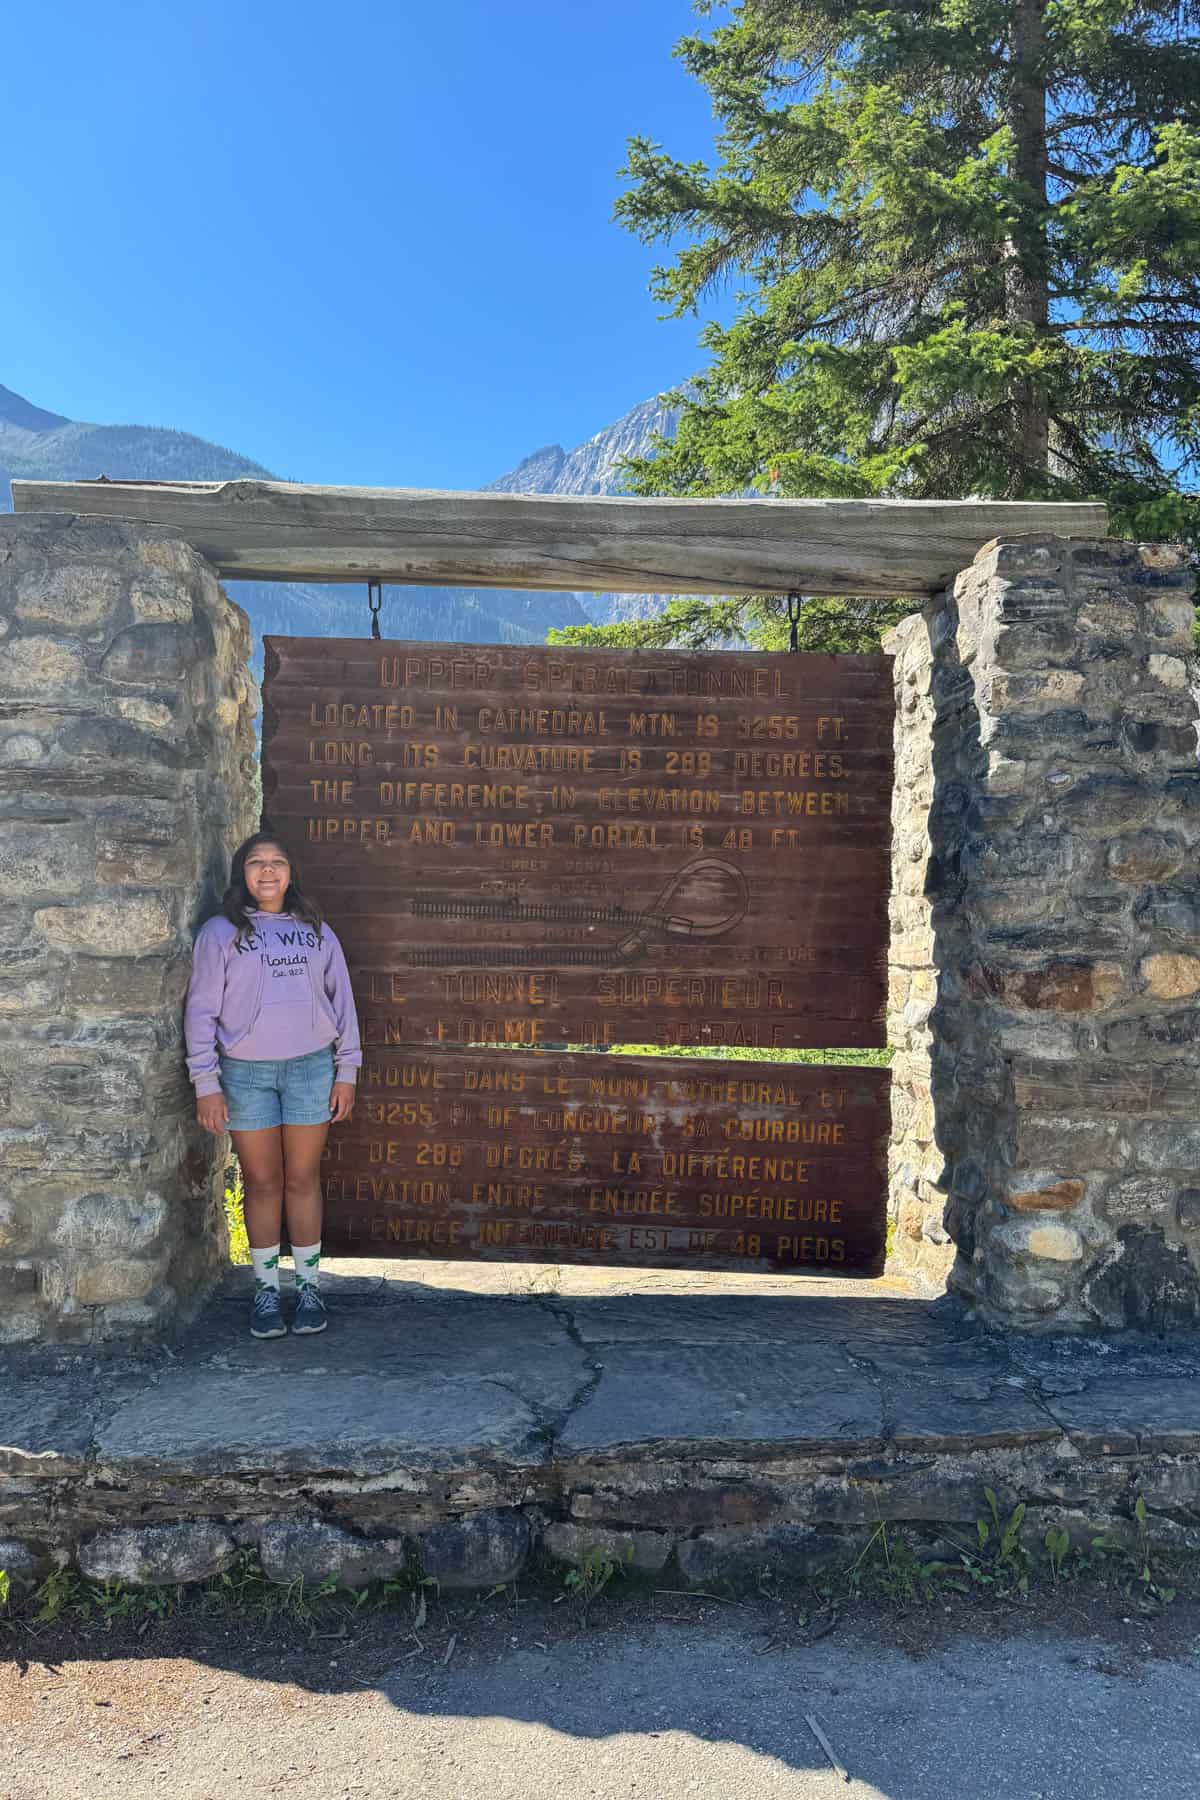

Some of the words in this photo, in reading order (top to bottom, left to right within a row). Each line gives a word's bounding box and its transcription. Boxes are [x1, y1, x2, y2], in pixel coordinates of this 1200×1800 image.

[380, 656, 491, 690] UPPER
[523, 662, 641, 697] SPIRAL
[310, 702, 416, 729] LOCATED
[435, 706, 458, 730] IN
[478, 707, 608, 736] CATHEDRAL
[696, 713, 720, 738] IS
[737, 714, 801, 740] 3255
[403, 742, 441, 769] ITS
[463, 744, 595, 771] CURVATURE
[620, 749, 642, 772] IS
[665, 751, 712, 776] 288
[310, 779, 353, 803] THE
[379, 781, 529, 810] DIFFERENCE
[551, 785, 577, 809] IN
[600, 786, 720, 814] ELEVATION
[742, 790, 849, 817] BETWEEN
[308, 818, 391, 843] UPPER
[409, 820, 456, 846] AND
[475, 822, 553, 849] LOWER
[574, 824, 662, 850] PORTAL
[682, 825, 704, 850] IS
[722, 828, 752, 851] 48
[234, 931, 266, 955] KEY
[261, 953, 308, 967] Florida
[371, 974, 407, 1004] LE
[441, 974, 561, 1006] TUNNEL
[437, 1016, 546, 1044] FORME
[464, 1066, 525, 1093] DANS
[543, 1071, 570, 1095] LE
[819, 1087, 849, 1109] ET
[488, 1104, 520, 1126] DE
[724, 1118, 845, 1145] COURBURE
[369, 1141, 400, 1165] DE
[613, 1151, 641, 1176] LA
[629, 1229, 672, 1250] EST
